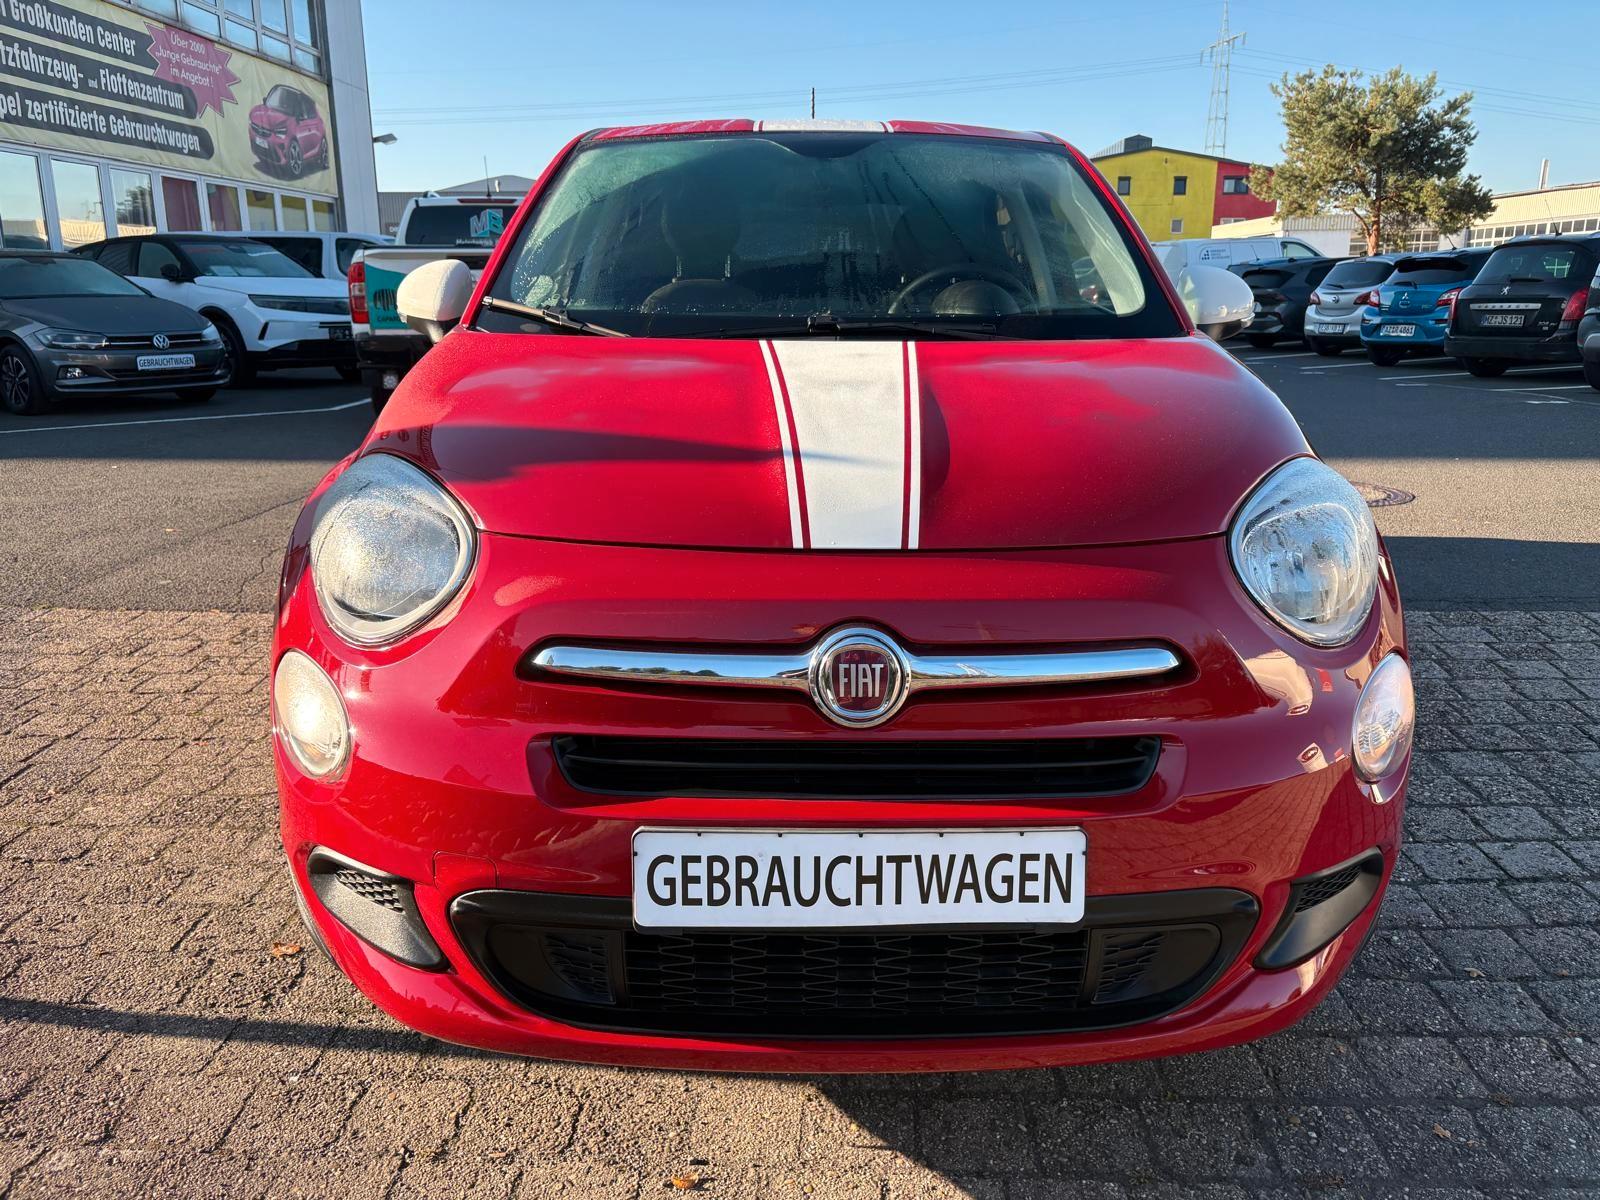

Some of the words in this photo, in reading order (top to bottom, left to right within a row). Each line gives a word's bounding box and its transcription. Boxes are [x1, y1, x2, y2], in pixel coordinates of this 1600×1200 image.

[10, 0, 95, 44] Großkunden
[97, 25, 136, 57] Center
[170, 31, 188, 49] Über
[88, 78, 98, 89] und
[99, 68, 185, 111] Flottenzentrum
[170, 64, 180, 77] im
[25, 98, 107, 134] zertifizierte
[109, 114, 201, 154] Gebrauchtwagen
[139, 356, 194, 368] GEBRAUCHTWAGEN
[838, 663, 885, 698] FIAT
[646, 852, 1074, 908] GEBRAUCHTWAGEN
